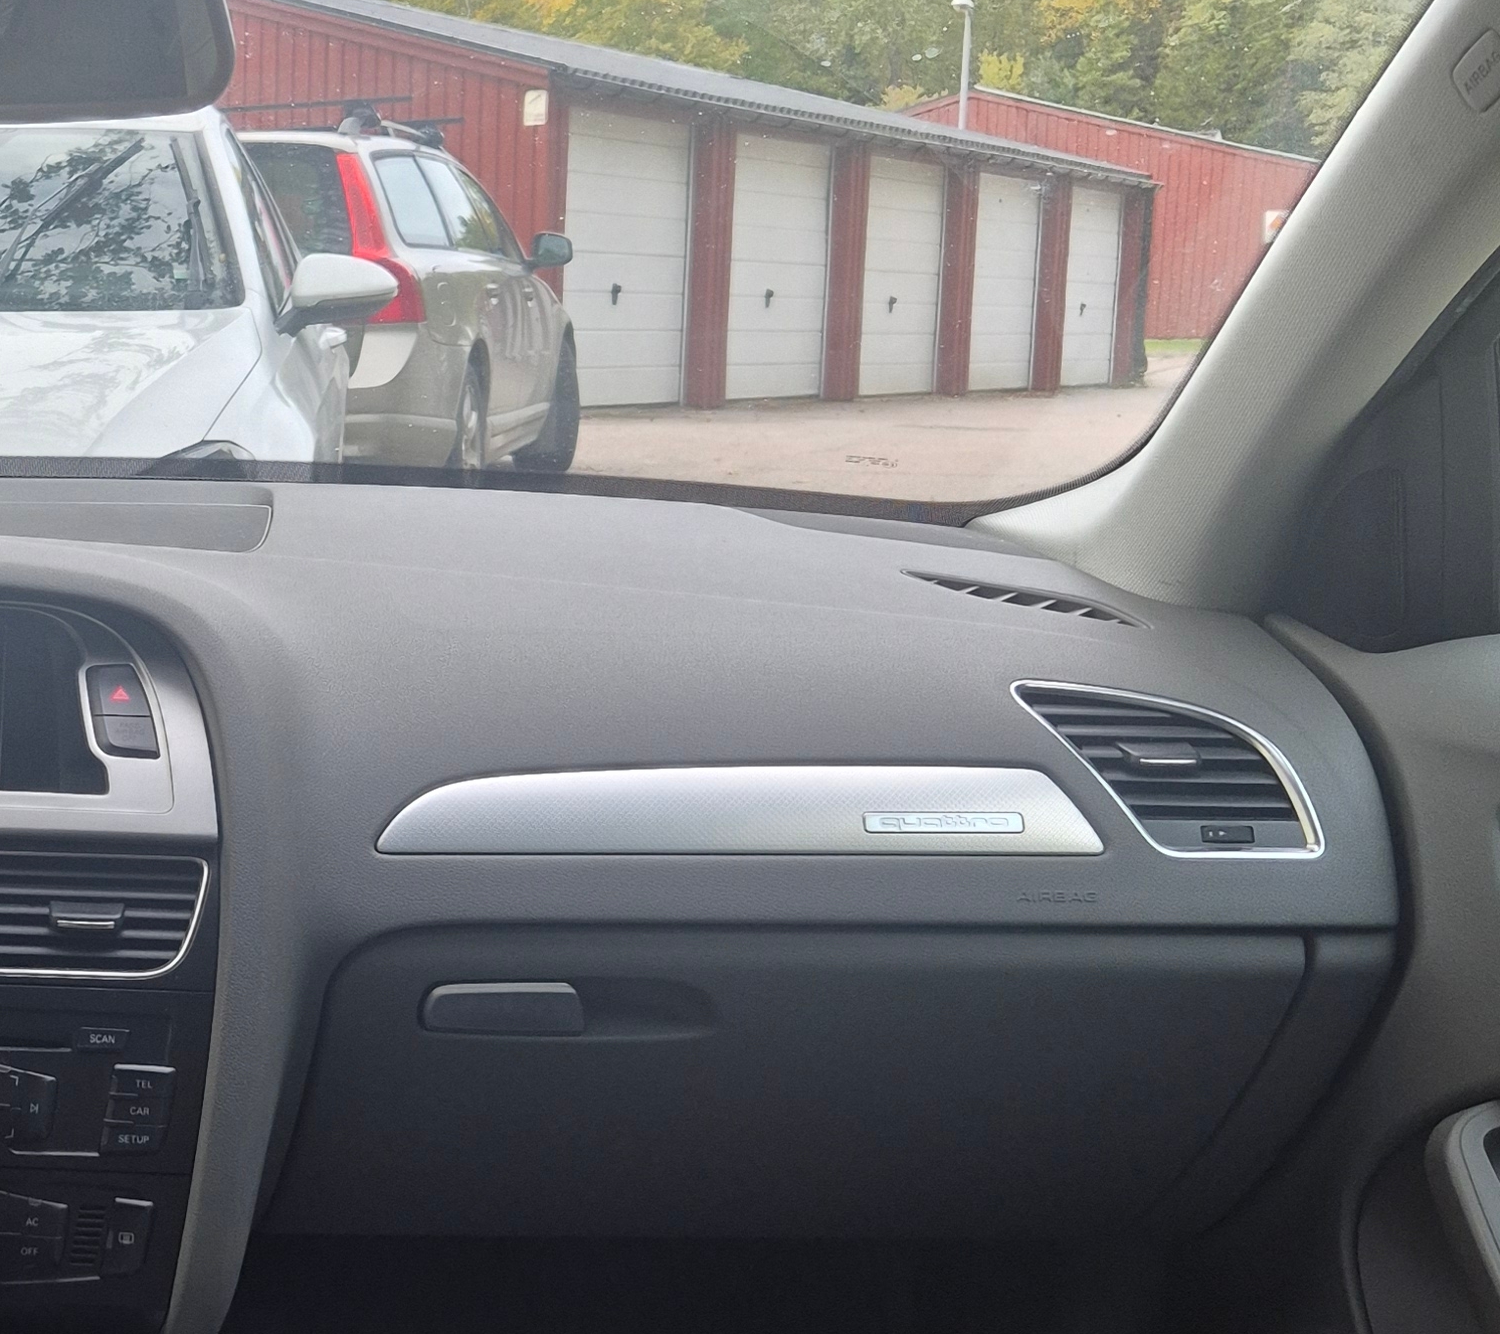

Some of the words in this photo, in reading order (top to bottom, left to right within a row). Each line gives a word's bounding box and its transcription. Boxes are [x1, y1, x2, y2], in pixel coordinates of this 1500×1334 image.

[879, 815, 1009, 830] quattro
[1016, 890, 1097, 903] AIRBAG
[89, 1033, 116, 1044] SCAN
[135, 1078, 153, 1089] TEL
[129, 1106, 150, 1116] CAR
[118, 1134, 150, 1144] SETUP
[25, 1217, 39, 1227] AC
[20, 1247, 38, 1256] OFF
